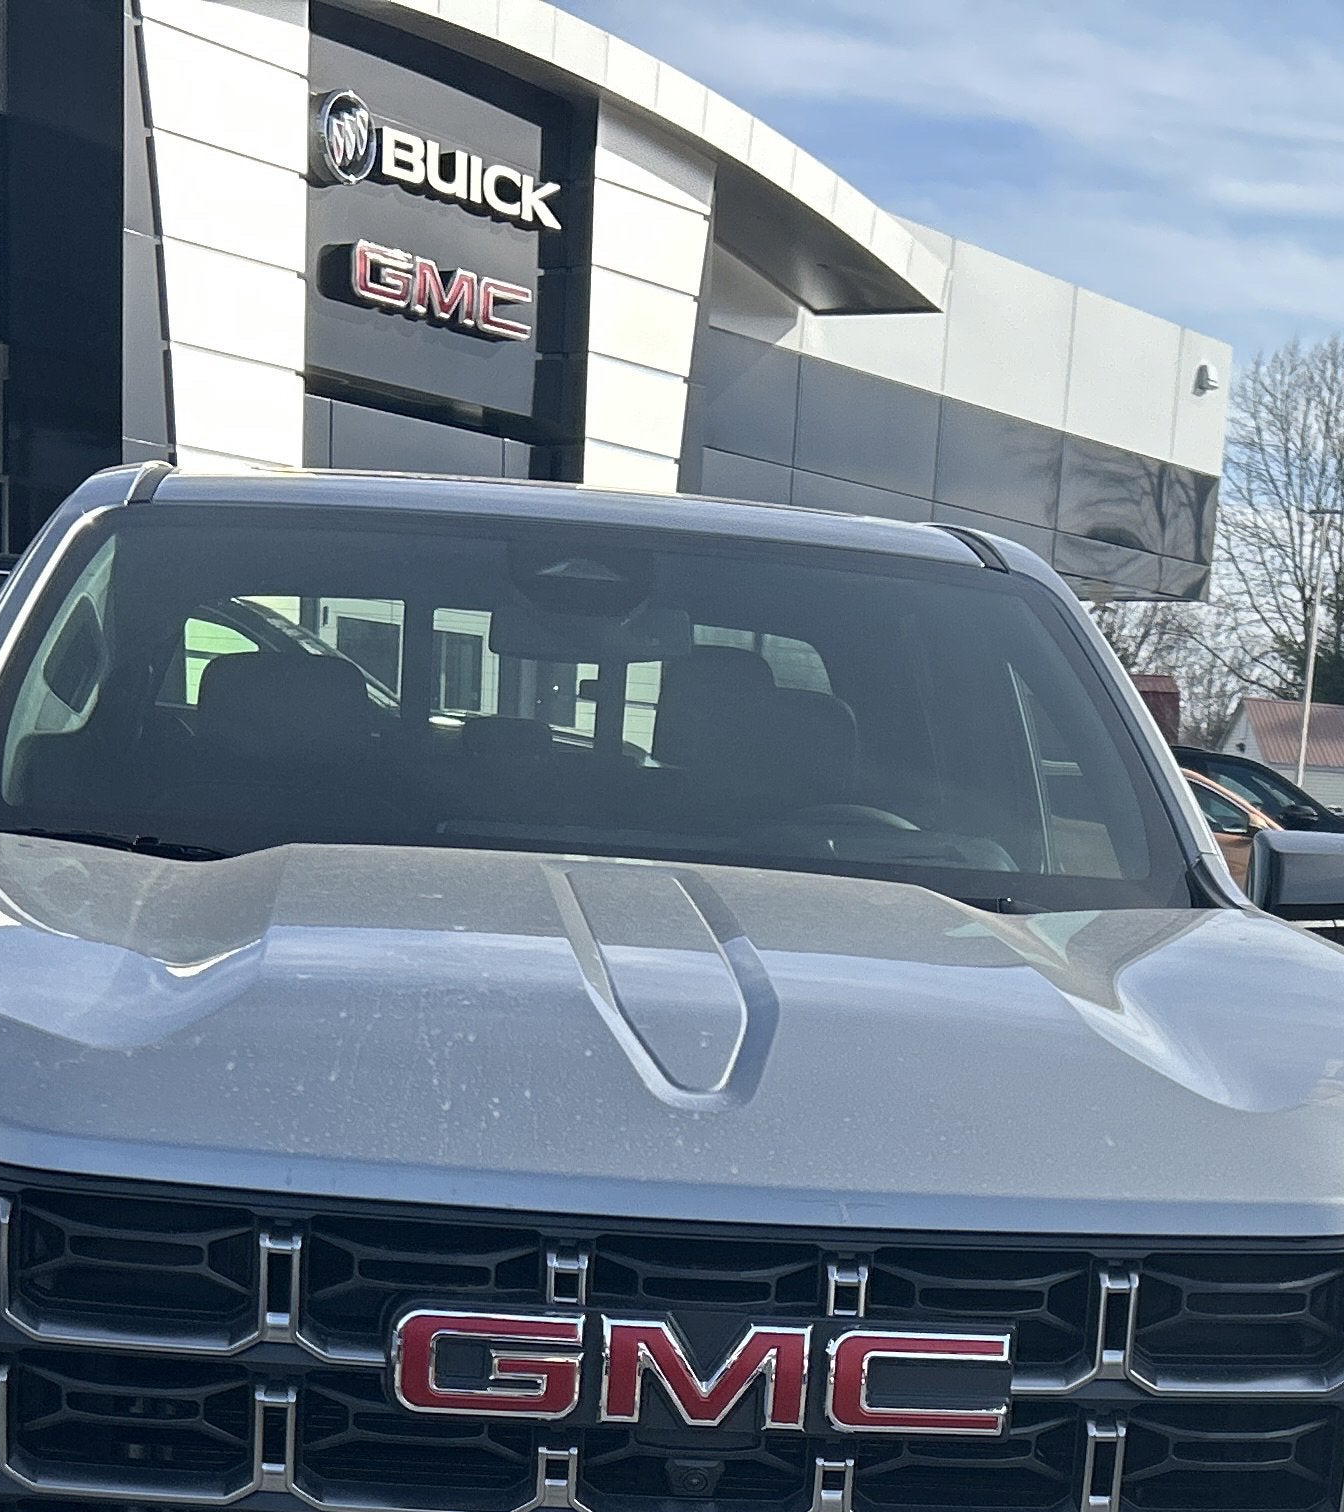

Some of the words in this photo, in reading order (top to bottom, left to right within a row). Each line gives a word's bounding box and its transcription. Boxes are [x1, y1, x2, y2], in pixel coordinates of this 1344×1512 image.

[381, 125, 562, 230] BUICK
[353, 238, 533, 342] GMC
[392, 1308, 1012, 1437] GMC
